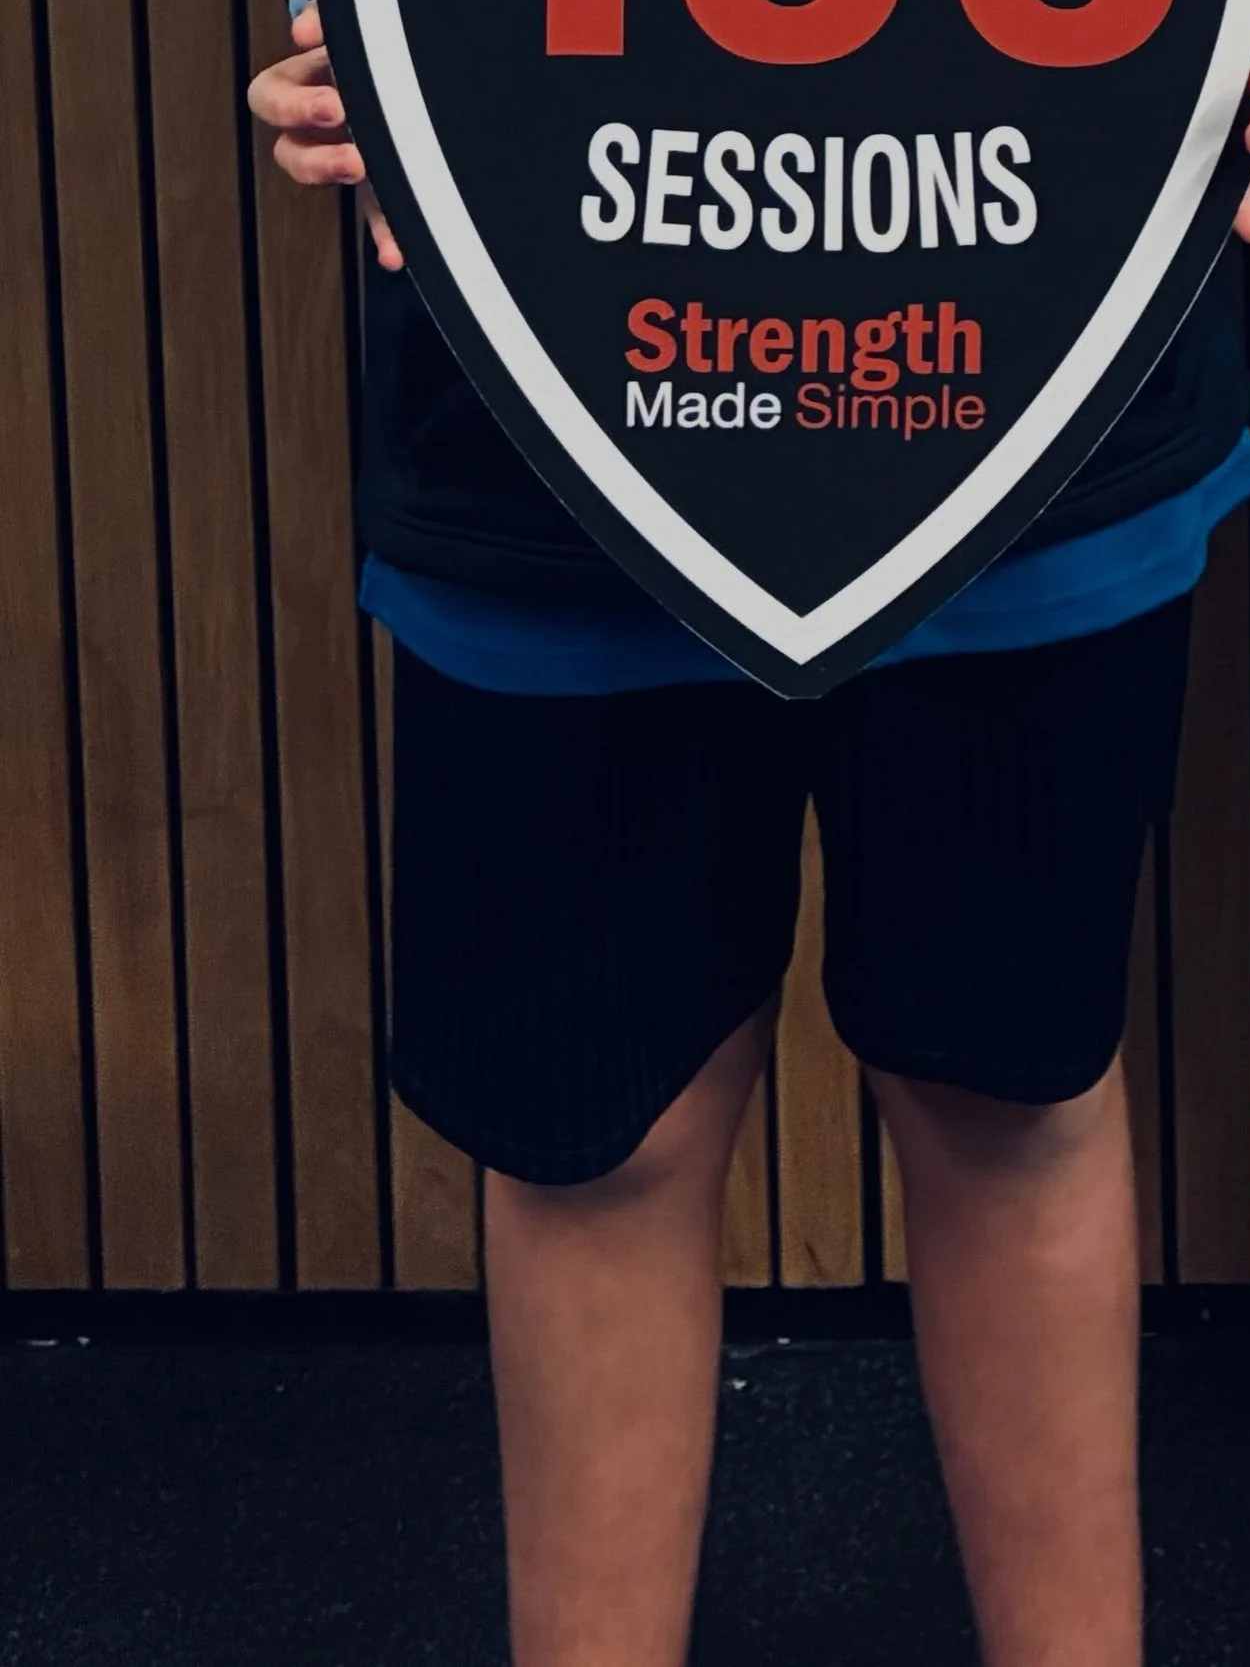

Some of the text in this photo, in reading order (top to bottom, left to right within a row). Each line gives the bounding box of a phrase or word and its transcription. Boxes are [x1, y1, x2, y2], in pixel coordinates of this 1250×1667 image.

[580, 122, 1038, 253] SESSIONS
[624, 298, 983, 391] Strength
[626, 381, 987, 441] Made Simple
